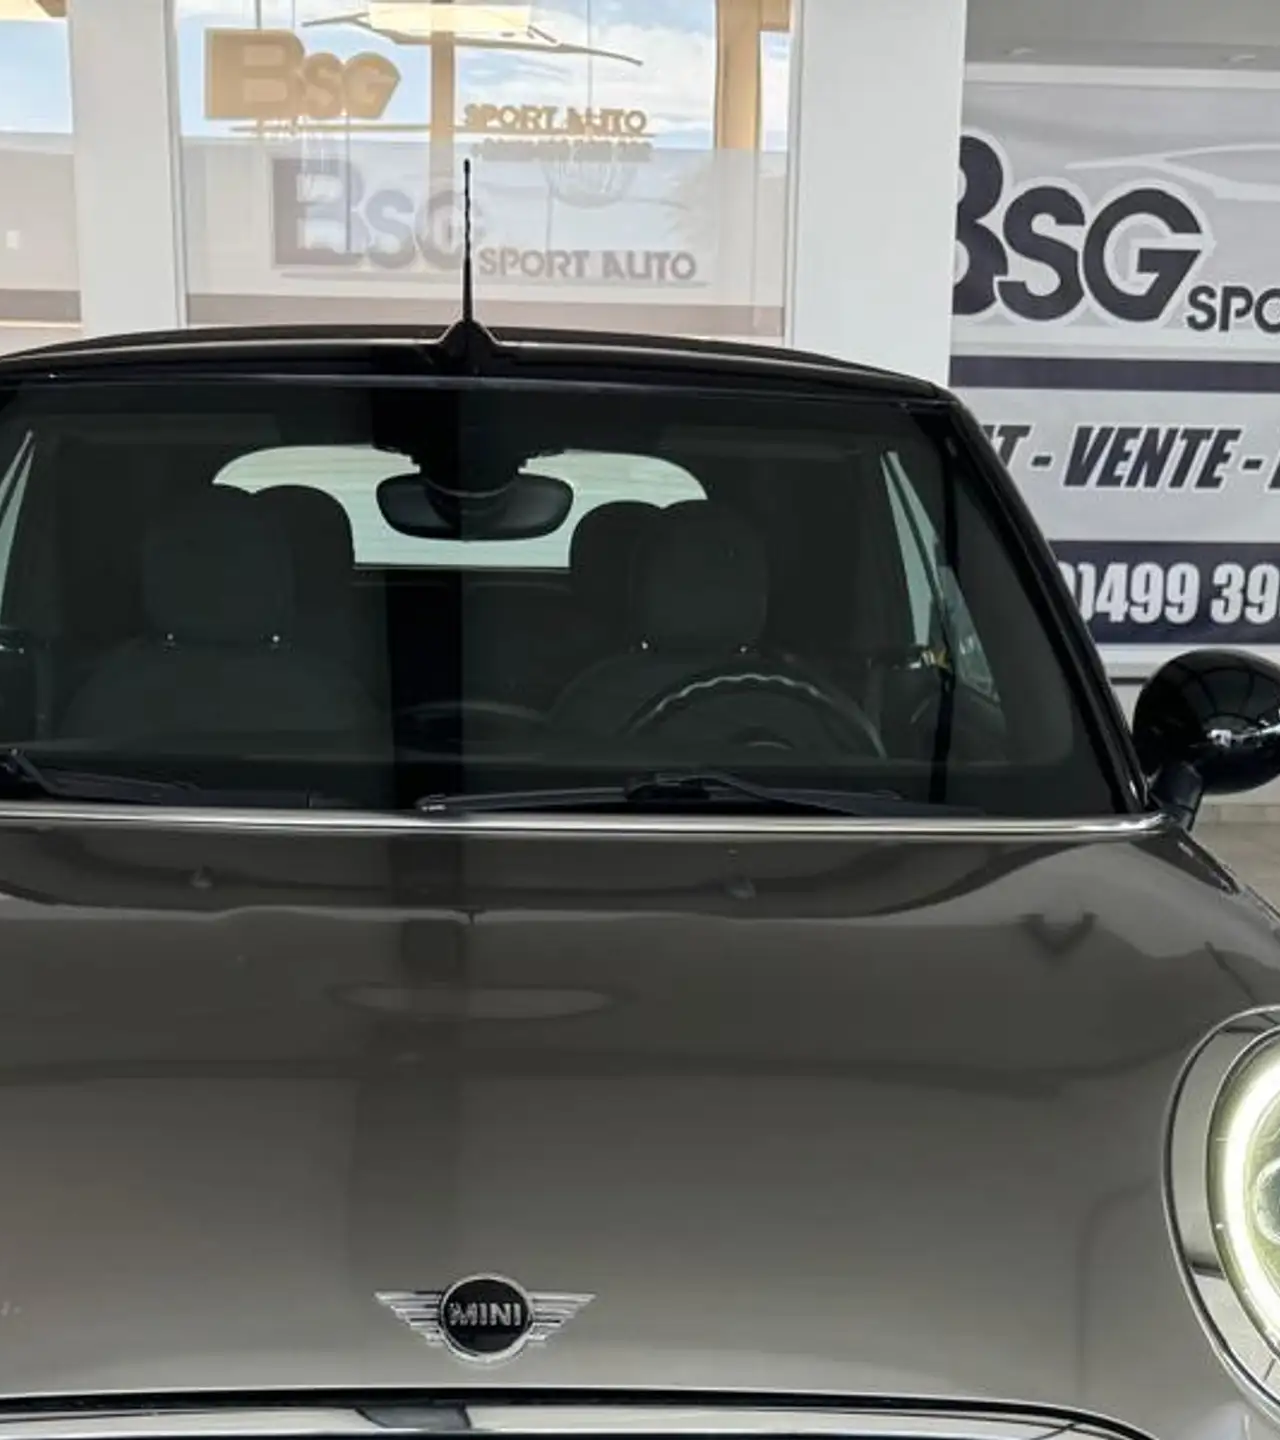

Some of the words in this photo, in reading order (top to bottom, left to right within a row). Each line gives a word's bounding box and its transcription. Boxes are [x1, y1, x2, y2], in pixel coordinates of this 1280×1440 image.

[204, 28, 402, 120] BSG
[463, 103, 557, 134] SPORT
[479, 249, 591, 280] SPORT
[601, 250, 698, 283] AUTO
[1063, 426, 1241, 489] VENTE
[449, 1302, 522, 1327] MINI
